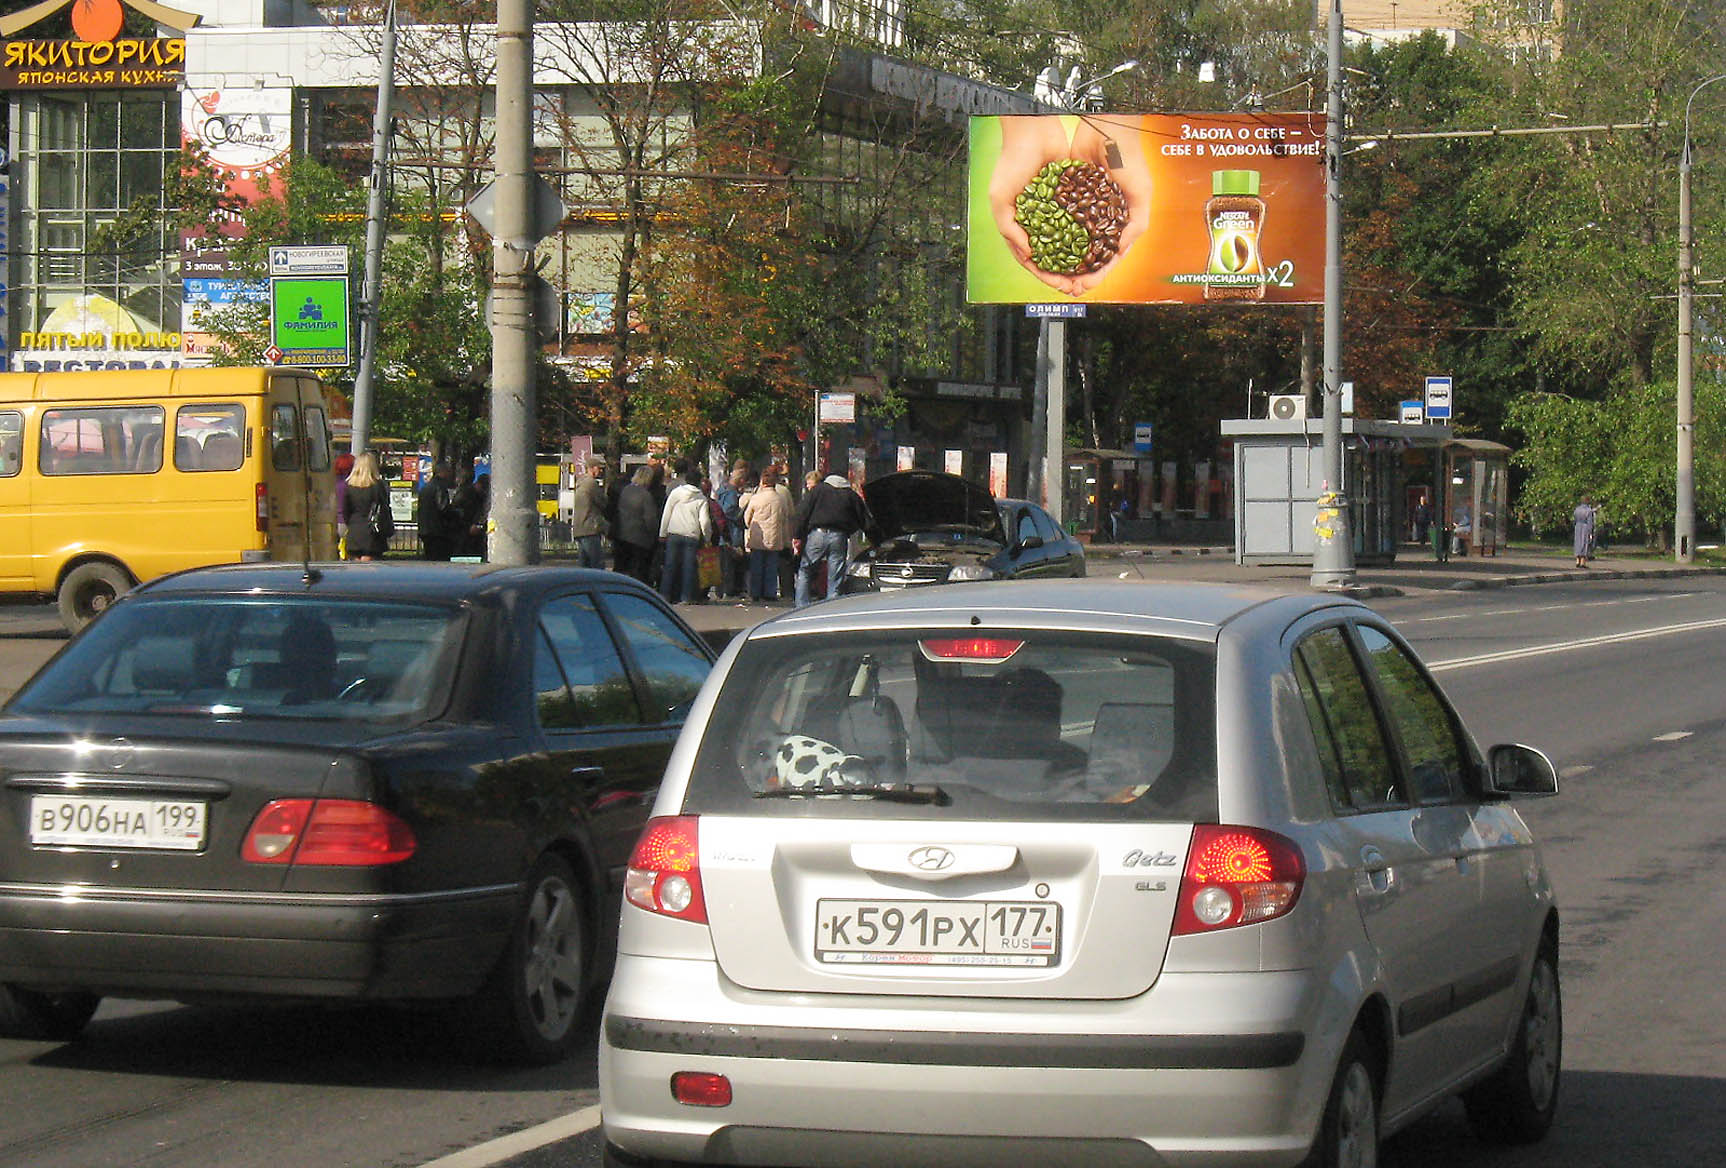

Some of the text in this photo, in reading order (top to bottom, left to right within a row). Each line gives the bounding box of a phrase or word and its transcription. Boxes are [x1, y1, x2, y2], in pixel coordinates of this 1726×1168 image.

[4, 39, 186, 68] ЯКИТОРИЯ
[18, 70, 115, 85] ЯПОНСКАЯ
[1161, 144, 1192, 156] СЕБЕ
[1209, 140, 1320, 158] УДОВОЛЬСТВИЕ!
[1213, 218, 1255, 230] Green
[1172, 273, 1266, 285] АНТИОКСИДАНТЫ
[1028, 304, 1069, 313] ОЛИМП
[283, 321, 339, 330] ФАМИЛИЯ
[20, 331, 104, 348] ПЯТЫЙ
[40, 803, 147, 834] В906НА
[156, 805, 198, 828] 199
[1122, 849, 1177, 868] Getz
[831, 906, 1048, 947] К591РХ 177
[1001, 938, 1030, 950] RUS
